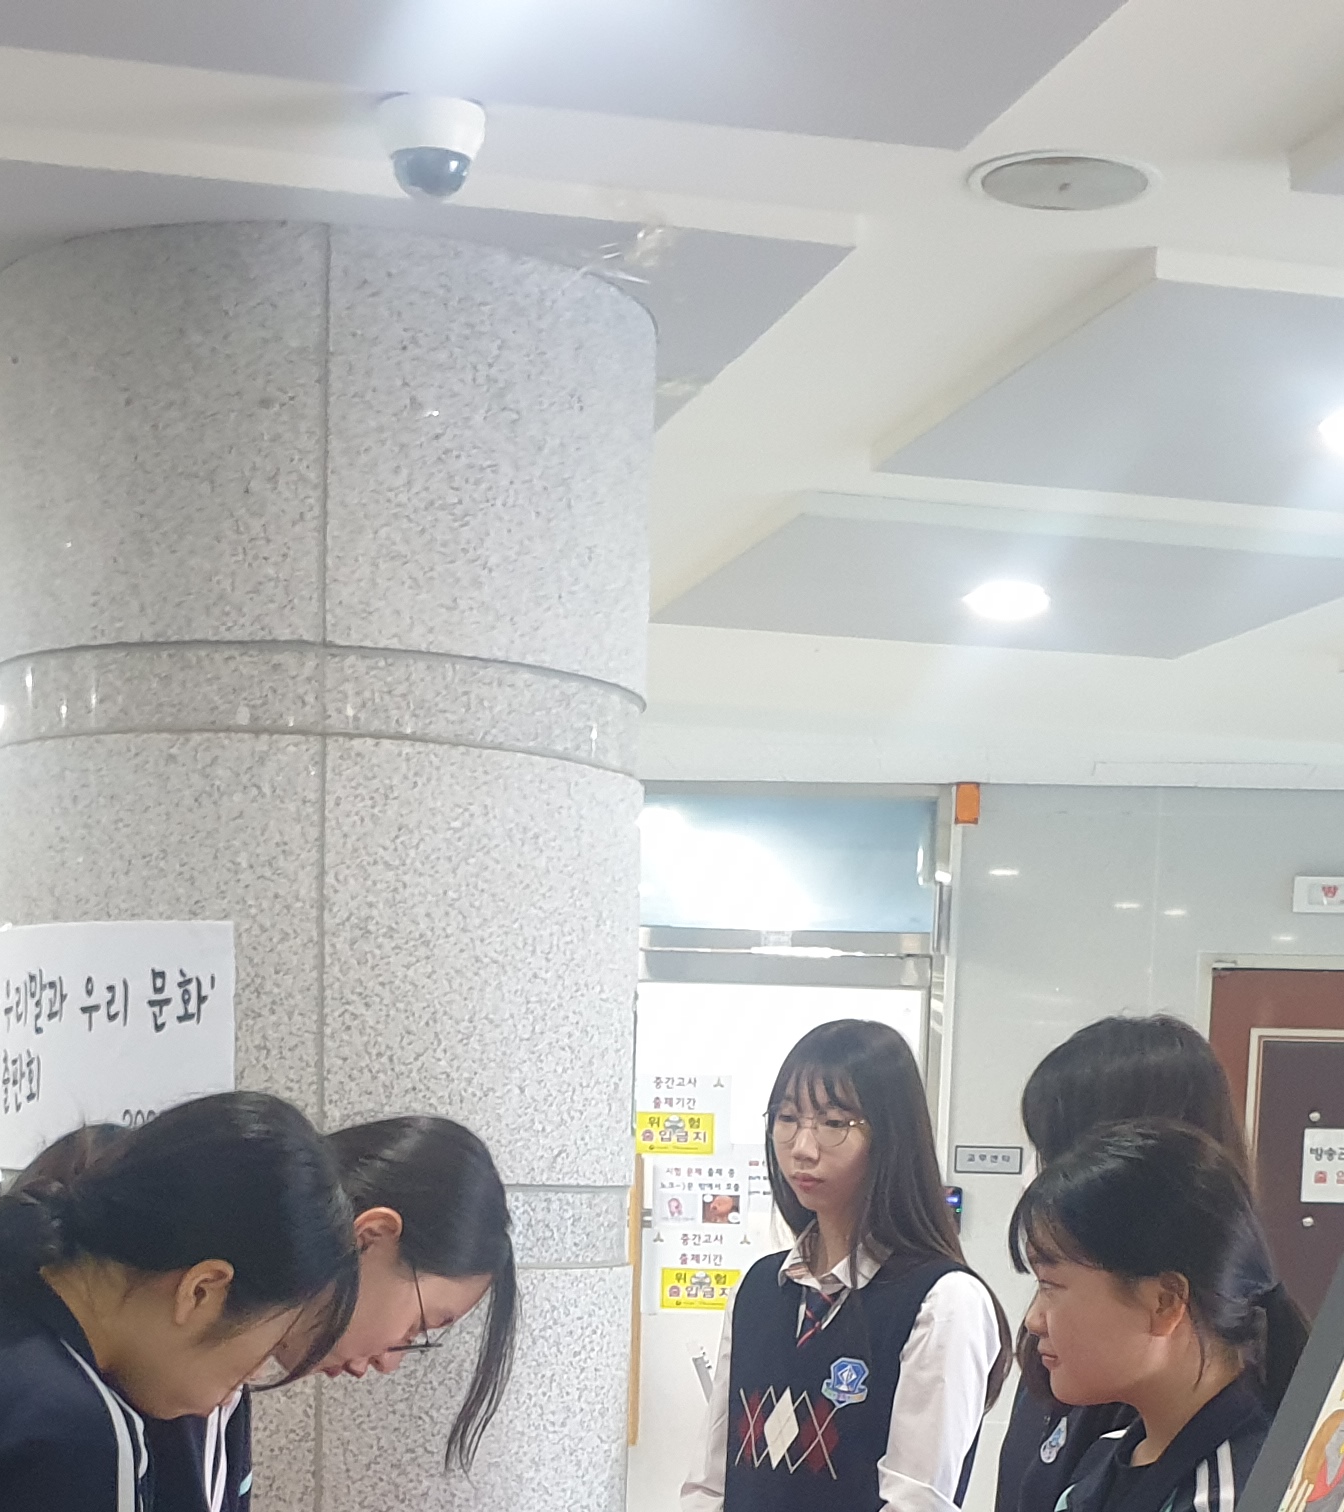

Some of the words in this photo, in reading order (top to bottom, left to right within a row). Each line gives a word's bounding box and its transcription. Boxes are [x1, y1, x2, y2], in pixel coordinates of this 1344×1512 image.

[80, 975, 130, 1033] 우리
[653, 1076, 698, 1090] 중간고사
[681, 1233, 724, 1246] 중간고사
